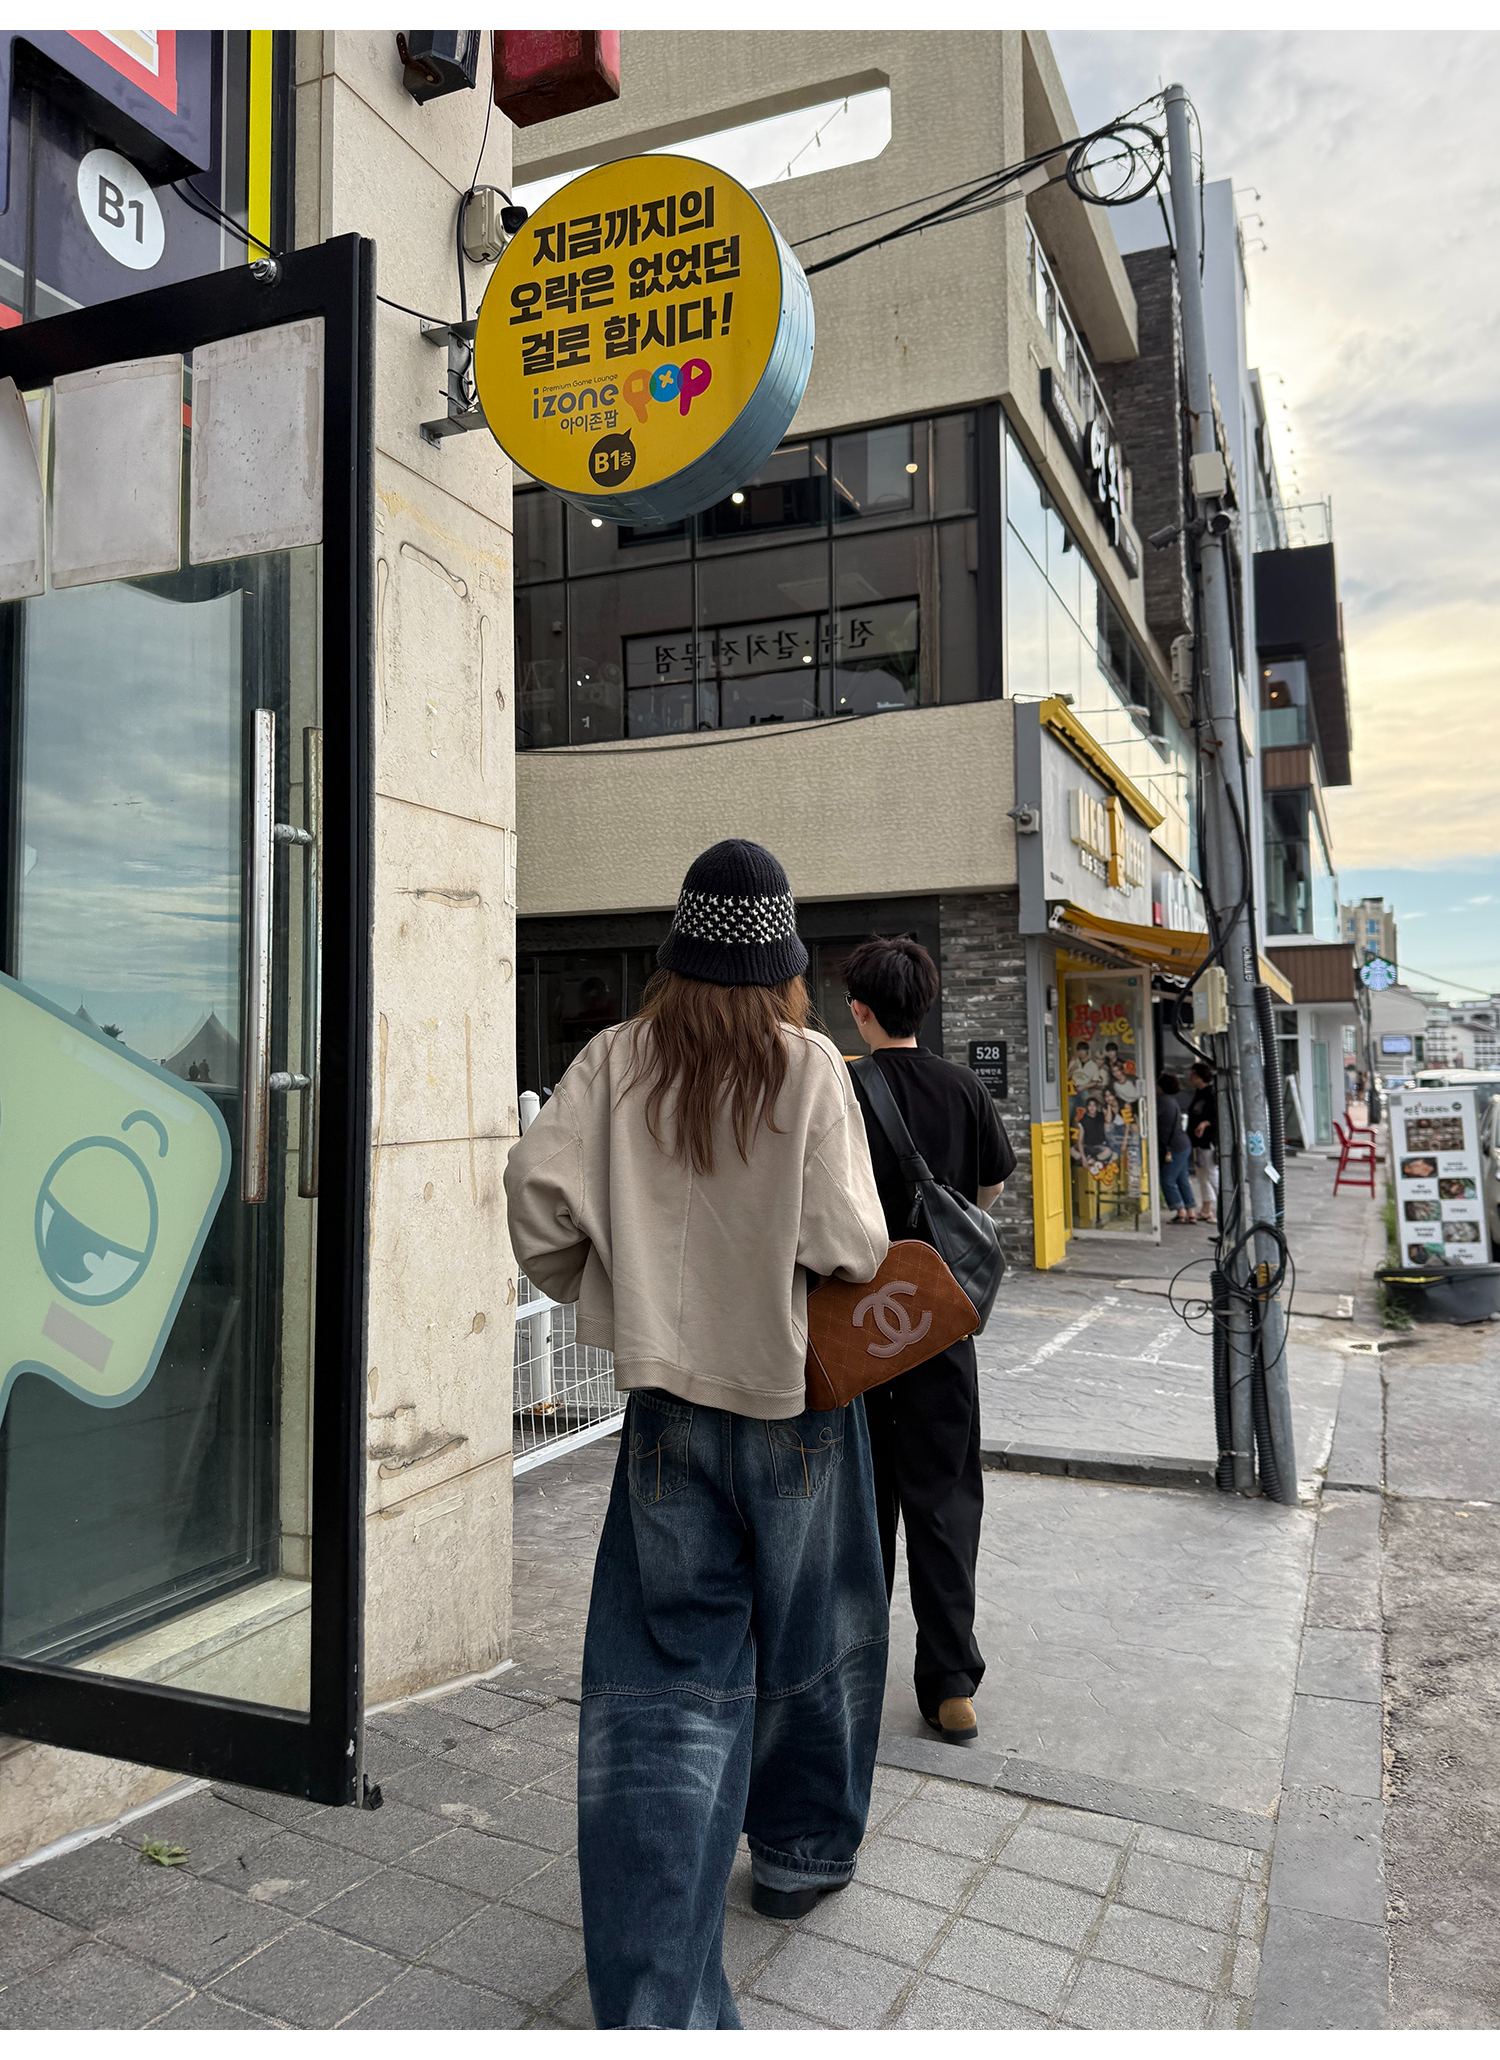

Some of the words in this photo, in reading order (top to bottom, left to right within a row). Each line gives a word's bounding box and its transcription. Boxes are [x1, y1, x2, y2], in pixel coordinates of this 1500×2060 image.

[97, 174, 144, 245] B1
[532, 186, 715, 267] 지금까지의
[509, 264, 615, 326] 오락은
[628, 235, 741, 299] 없었던
[522, 323, 591, 377] 걸로
[604, 292, 734, 360] 합시다!
[542, 383, 572, 393] Premium
[572, 378, 593, 389] Game
[593, 374, 618, 384] Lounge
[533, 384, 619, 419] izone
[594, 450, 632, 474] B1층
[1074, 1004, 1124, 1024] Hello
[976, 1046, 1000, 1060] 528
